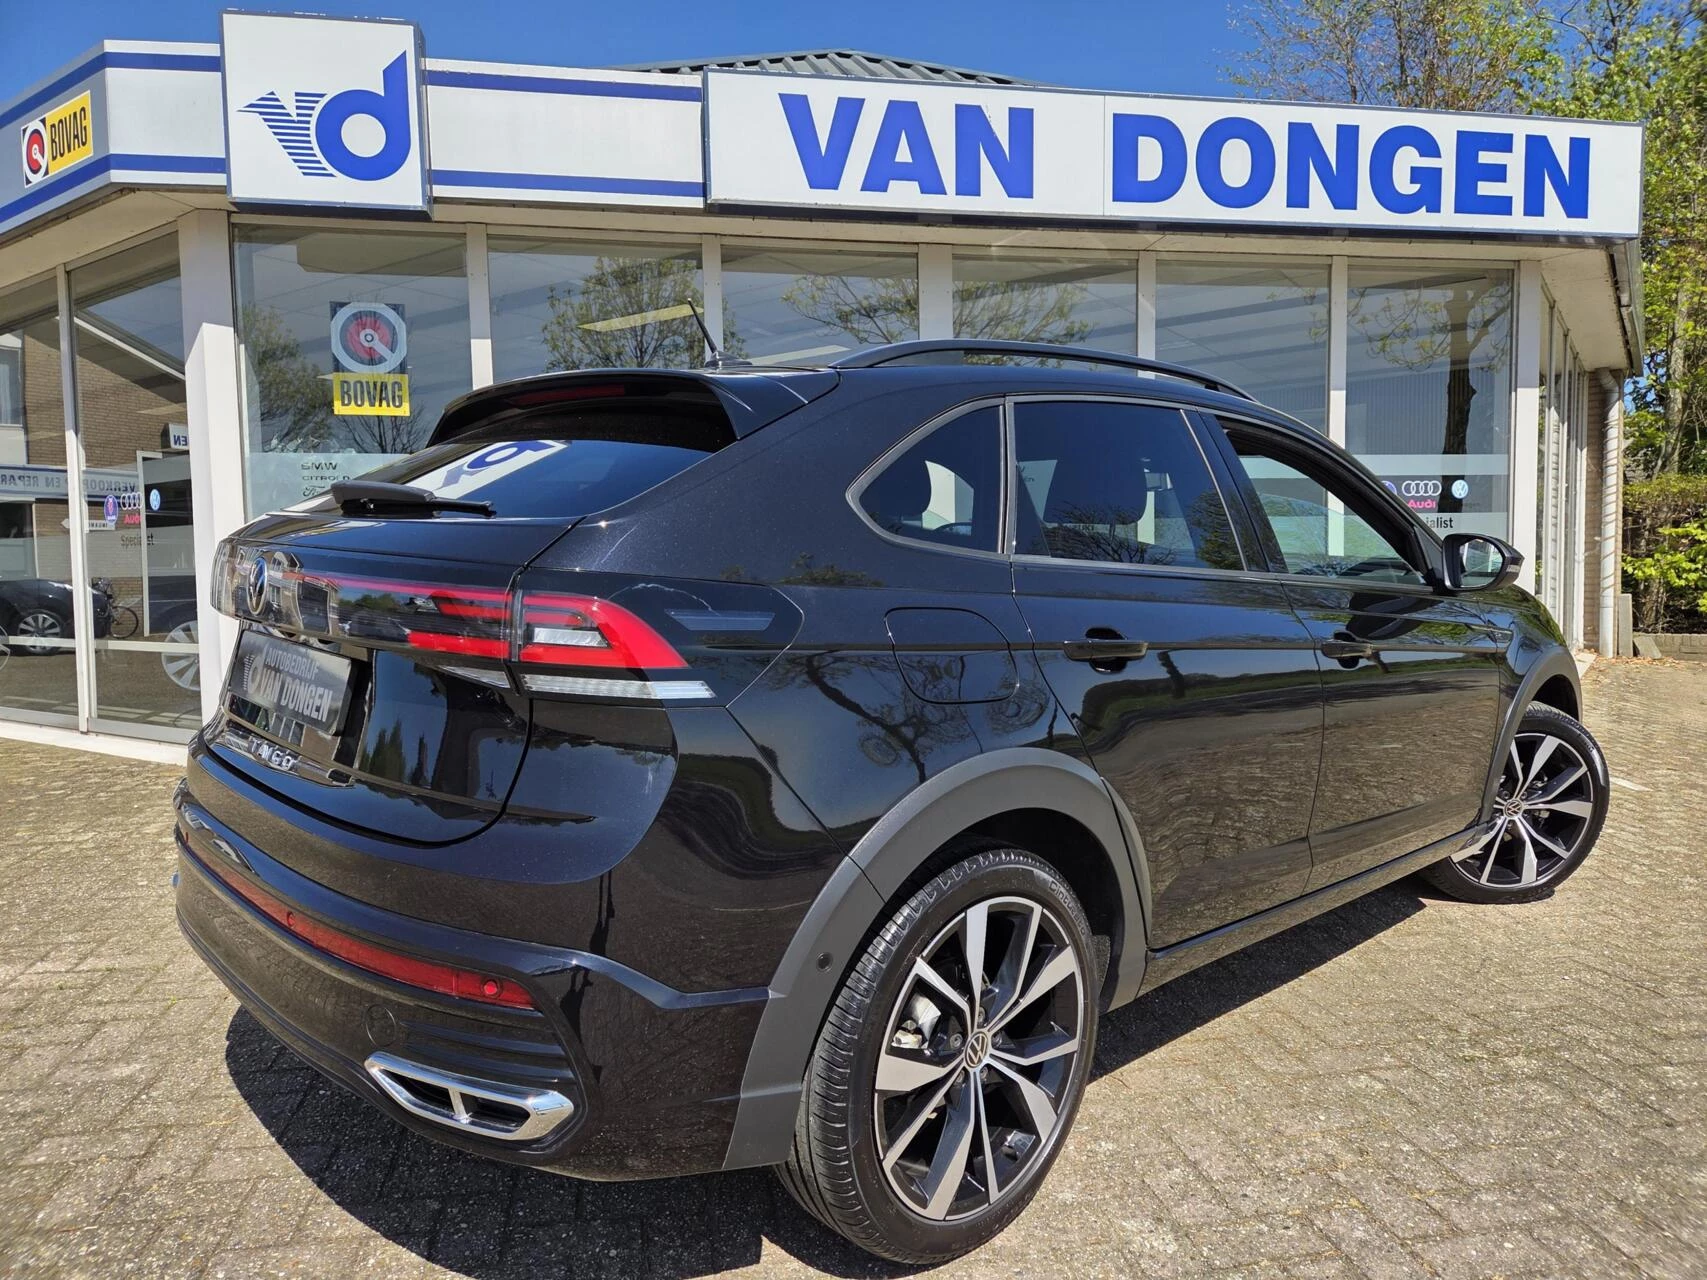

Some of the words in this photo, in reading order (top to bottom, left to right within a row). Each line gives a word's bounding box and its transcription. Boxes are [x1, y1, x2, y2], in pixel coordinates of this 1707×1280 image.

[50, 106, 87, 161] BOVAG
[778, 93, 1034, 199] VAN
[1112, 112, 1591, 219] DONGEN
[340, 380, 403, 408] BOVAG
[1408, 499, 1437, 509] Audi
[264, 647, 320, 681] AUTOBEDRIJF
[259, 667, 284, 703] VAN
[280, 678, 334, 722] DONGEN
